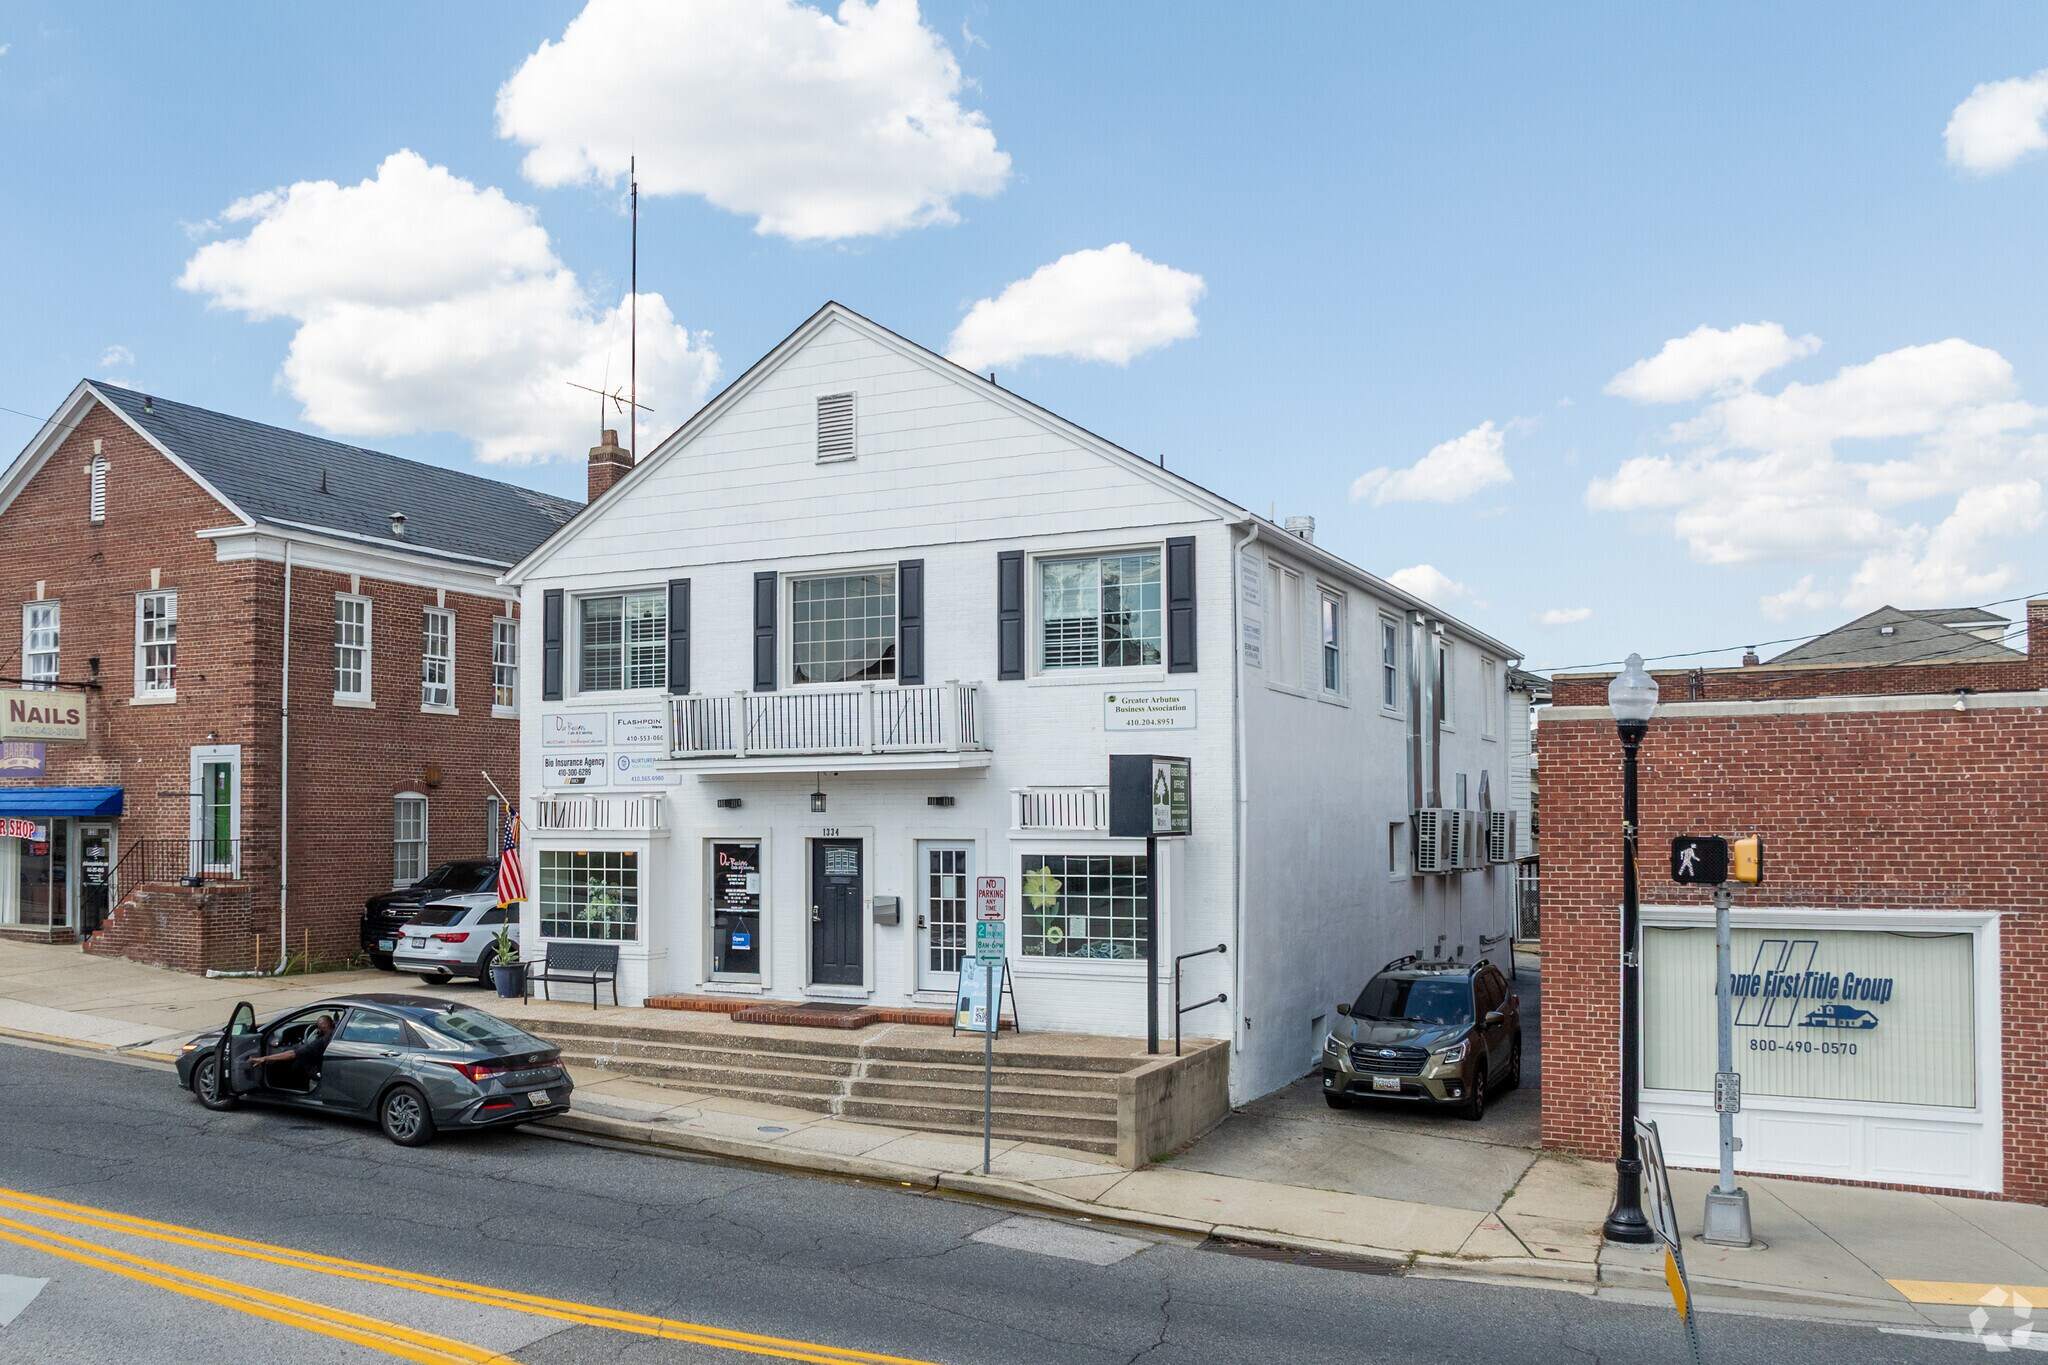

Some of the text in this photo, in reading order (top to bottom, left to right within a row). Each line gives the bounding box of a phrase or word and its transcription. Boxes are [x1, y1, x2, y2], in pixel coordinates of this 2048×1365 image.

[1115, 704, 1187, 713] Business Association
[1126, 718, 1175, 726] 410.204.8951
[626, 734, 663, 742] 410-553-060
[545, 757, 605, 768] Bio Insurance Agency
[9, 819, 35, 839] SHOP
[822, 828, 839, 836] 1334
[985, 879, 997, 888] NO
[978, 889, 1004, 898] PARKING
[978, 924, 985, 936] 2
[1715, 970, 1893, 1004] ome First Title Group
[1749, 1038, 1858, 1055] 800-490-0570
